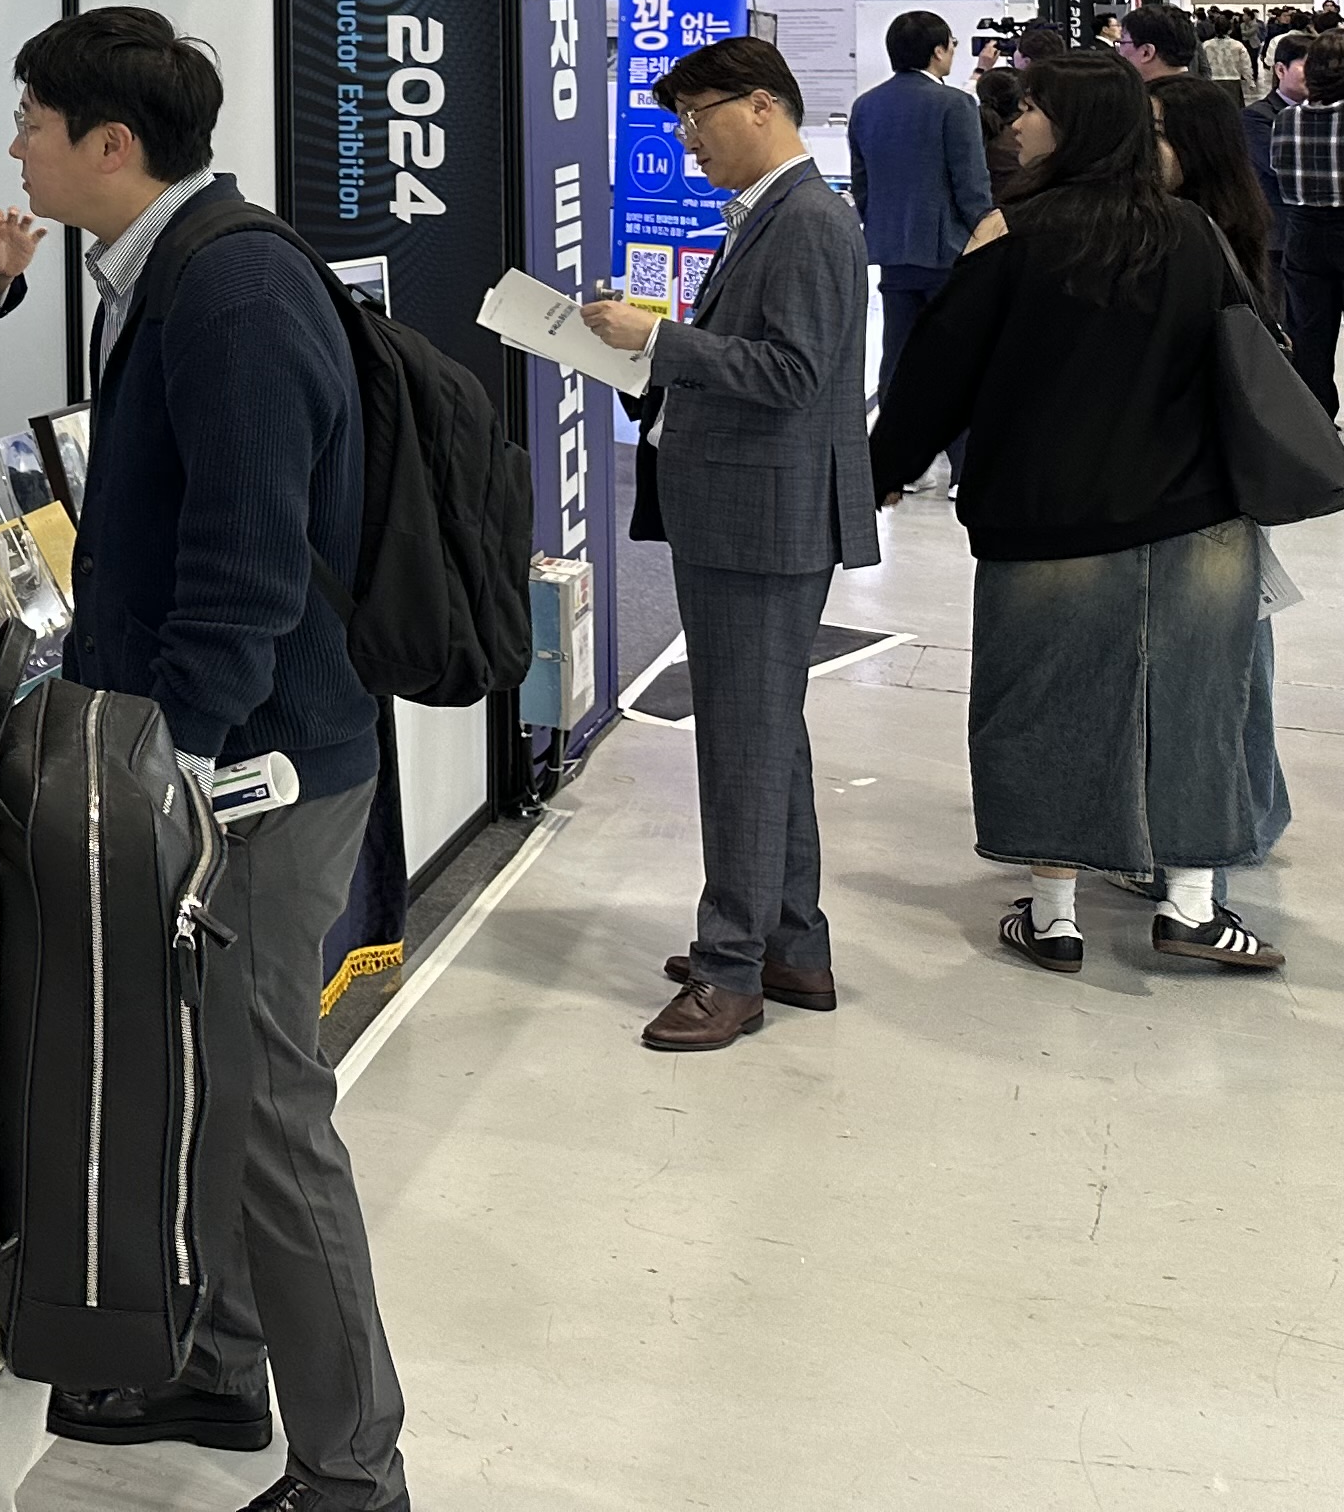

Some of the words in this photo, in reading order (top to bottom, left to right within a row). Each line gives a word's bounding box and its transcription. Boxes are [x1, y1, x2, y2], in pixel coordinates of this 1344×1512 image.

[338, 83, 365, 221] Exhibition
[386, 14, 447, 225] 2024
[636, 152, 669, 175] 11시
